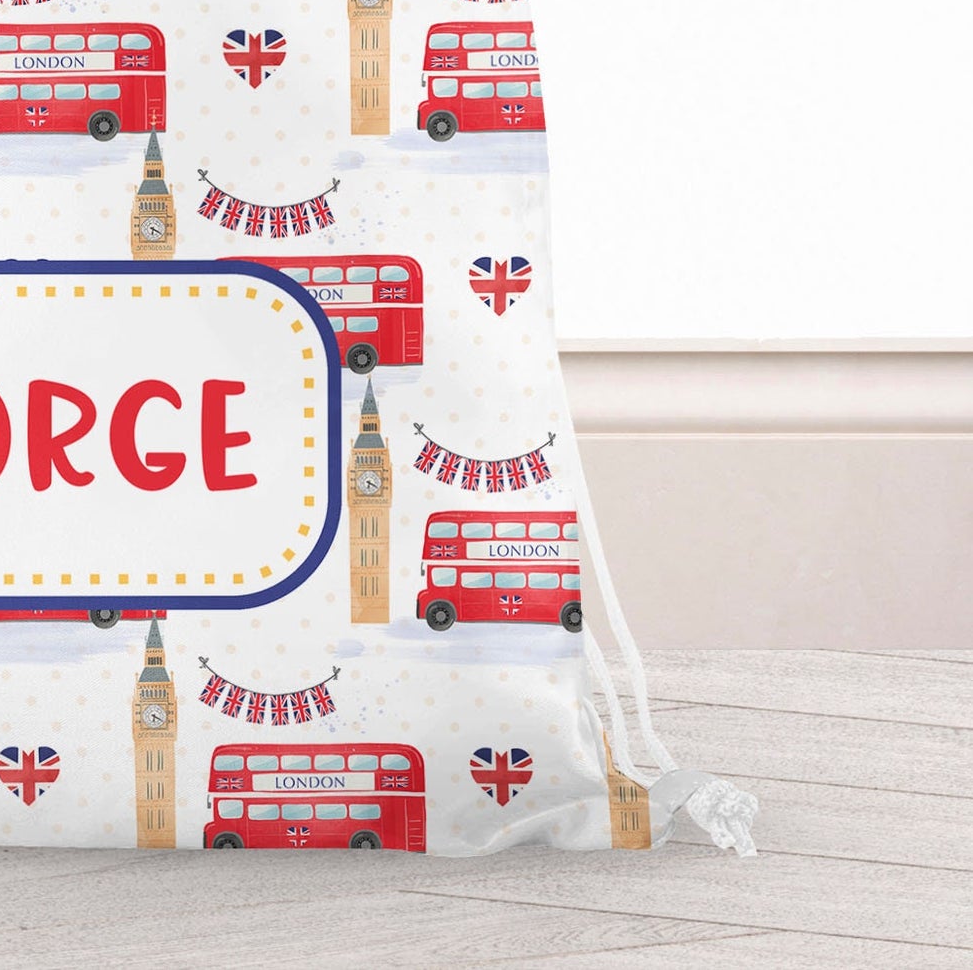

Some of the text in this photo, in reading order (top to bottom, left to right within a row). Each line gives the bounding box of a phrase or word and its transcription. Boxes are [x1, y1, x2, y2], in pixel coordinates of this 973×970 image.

[14, 55, 86, 69] LONDON
[490, 53, 539, 67] LOND
[489, 544, 560, 557] LONDON
[275, 776, 346, 789] LONDON
